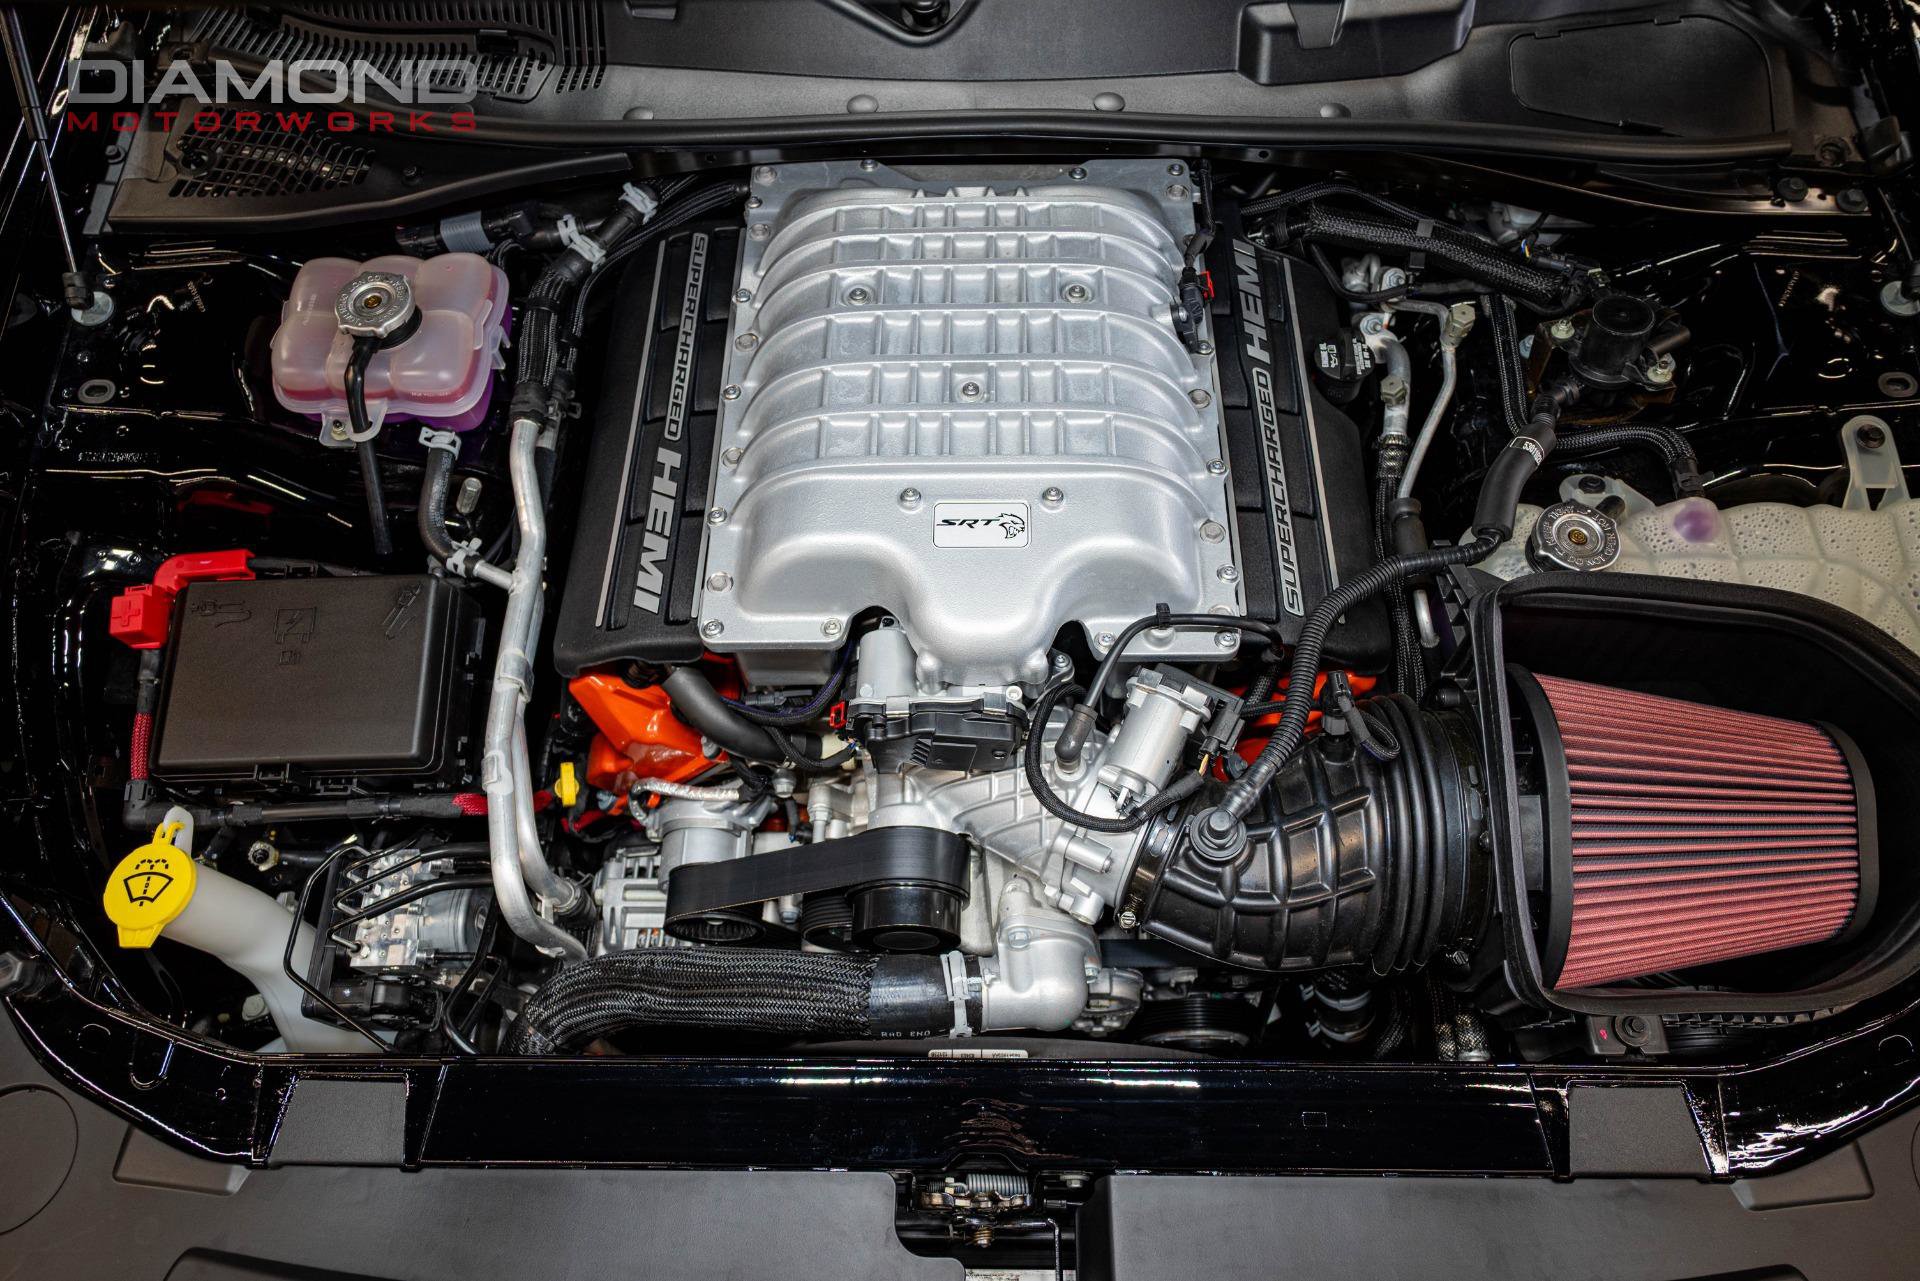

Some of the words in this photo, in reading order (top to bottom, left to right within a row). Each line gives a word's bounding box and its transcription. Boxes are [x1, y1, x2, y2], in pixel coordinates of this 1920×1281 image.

[666, 235, 706, 440] SUPERCHARGED
[1232, 239, 1271, 365] HEMI
[633, 447, 682, 615] HEMI
[936, 518, 1000, 529] SRT
[1255, 370, 1302, 613] SUPERCHARGED
